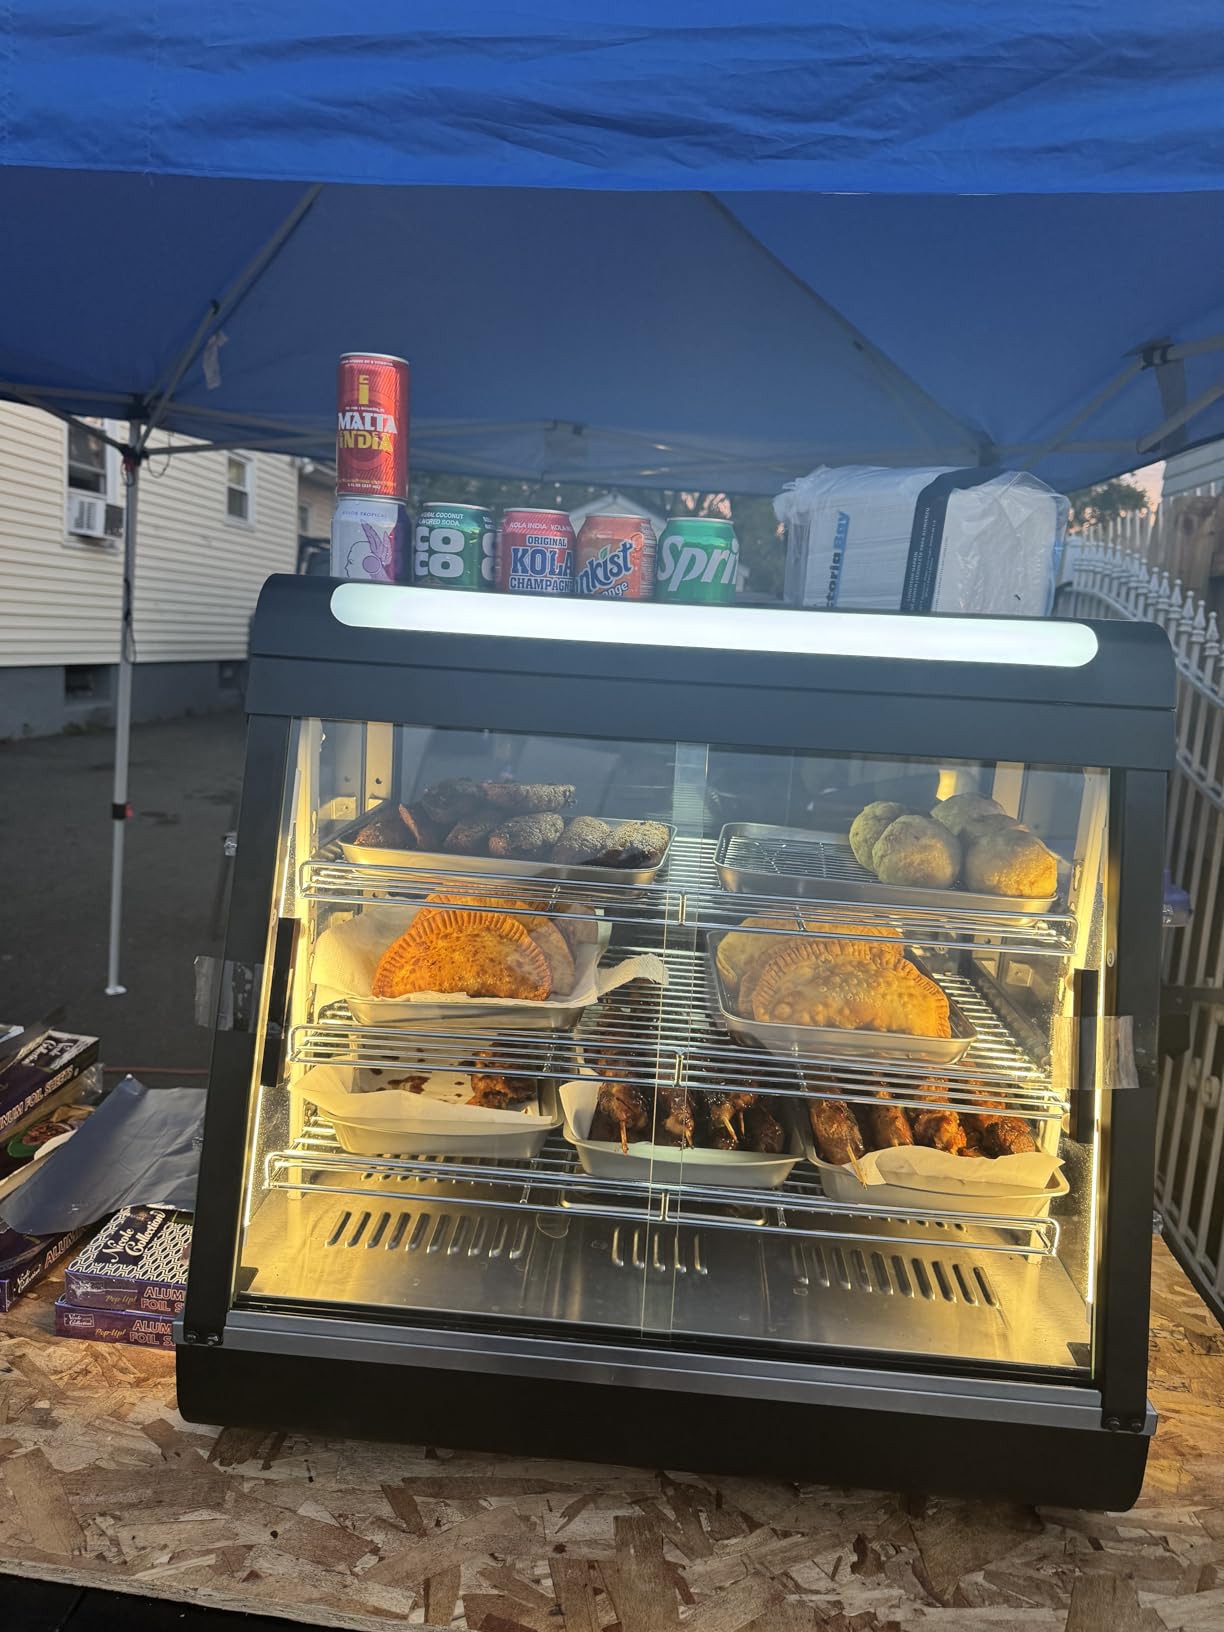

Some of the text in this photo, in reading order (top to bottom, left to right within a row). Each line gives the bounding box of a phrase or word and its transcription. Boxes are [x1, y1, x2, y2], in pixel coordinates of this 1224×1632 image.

[338, 411, 398, 434] MALTA
[435, 511, 464, 520] COCONUT
[527, 535, 567, 548] ORIGINAL
[511, 546, 574, 578] KOLA
[125, 1209, 166, 1257] Collection
[102, 1227, 135, 1263] Nicole
[141, 1298, 171, 1312] FOIL
[95, 1327, 127, 1338] Pop-Up!
[129, 1331, 160, 1345] FOIL
